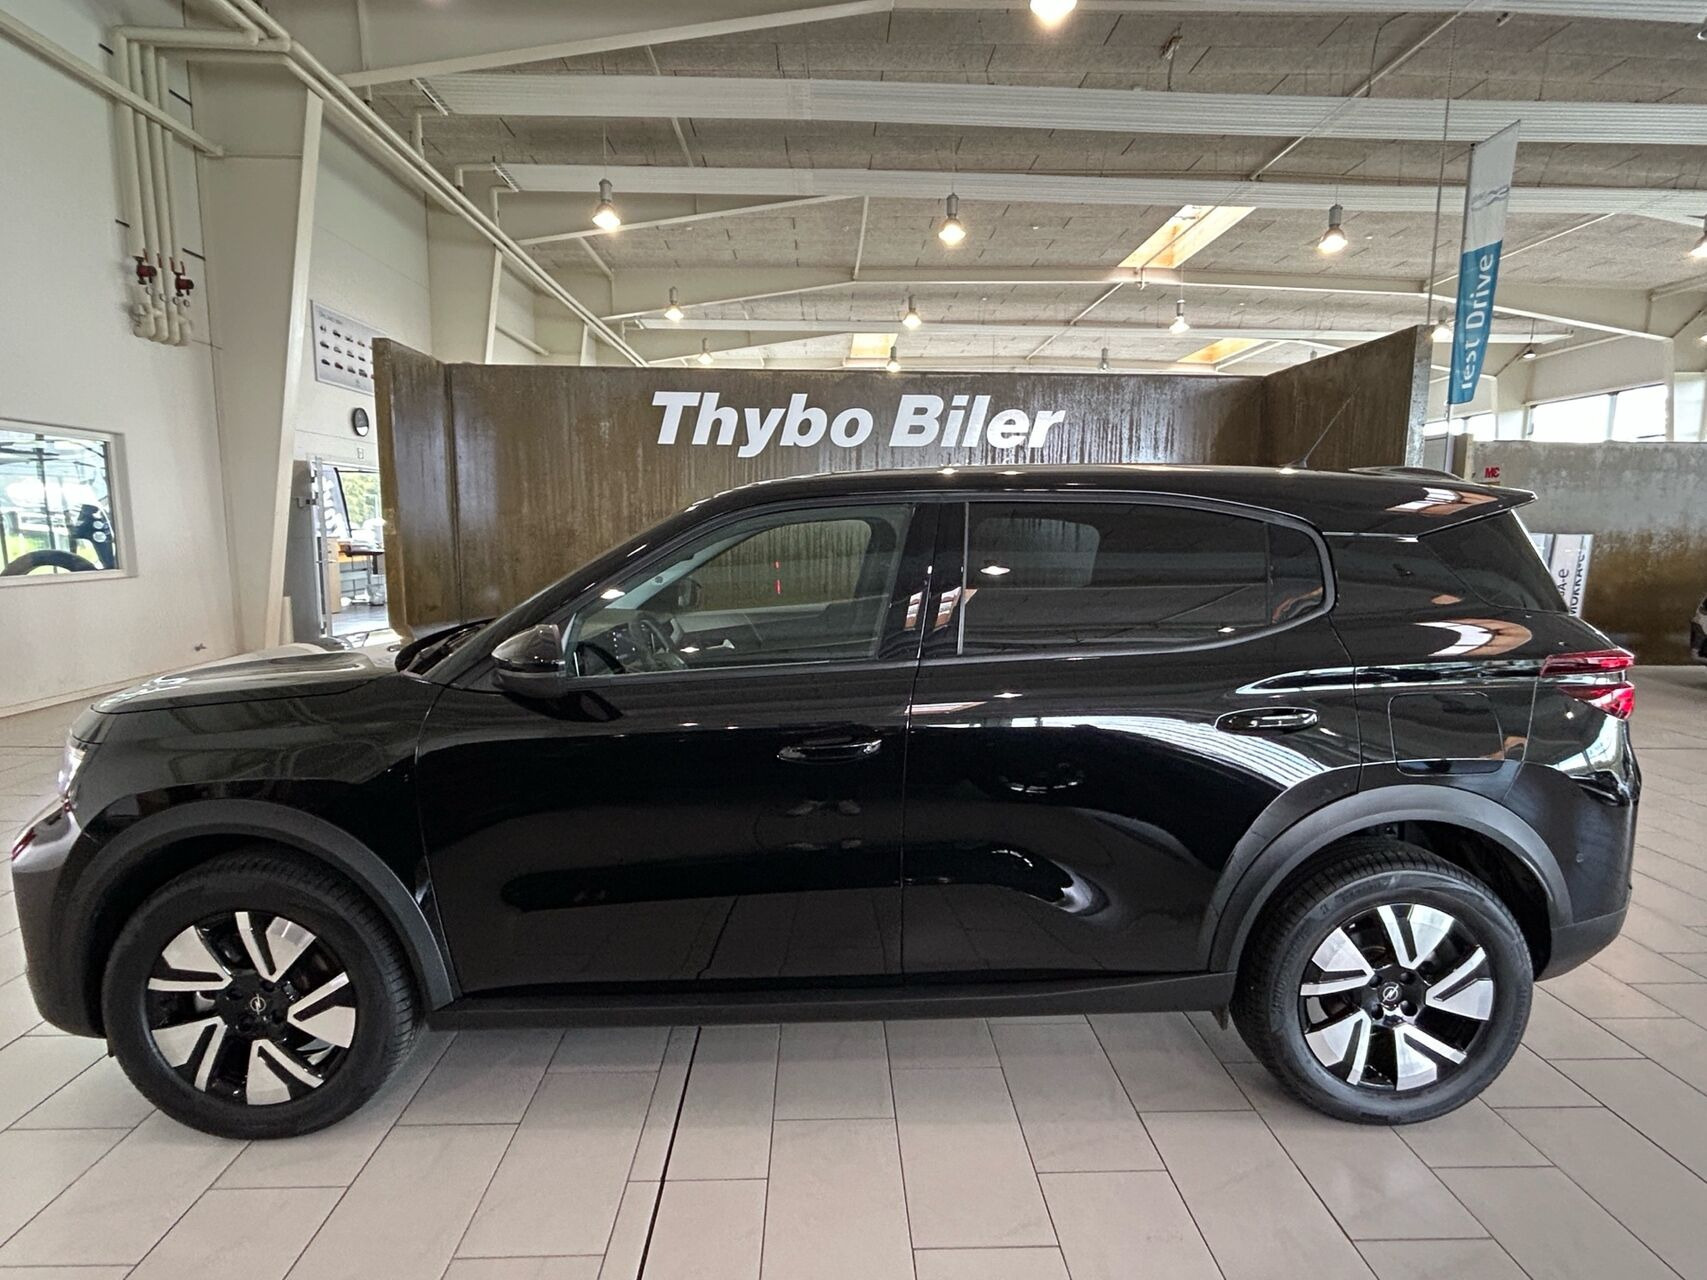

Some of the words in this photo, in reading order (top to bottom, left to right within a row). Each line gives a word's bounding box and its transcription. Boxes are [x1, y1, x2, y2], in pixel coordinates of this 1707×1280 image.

[1465, 253, 1494, 330] Drive
[652, 391, 873, 458] Thybo
[889, 394, 1065, 448] Biler
